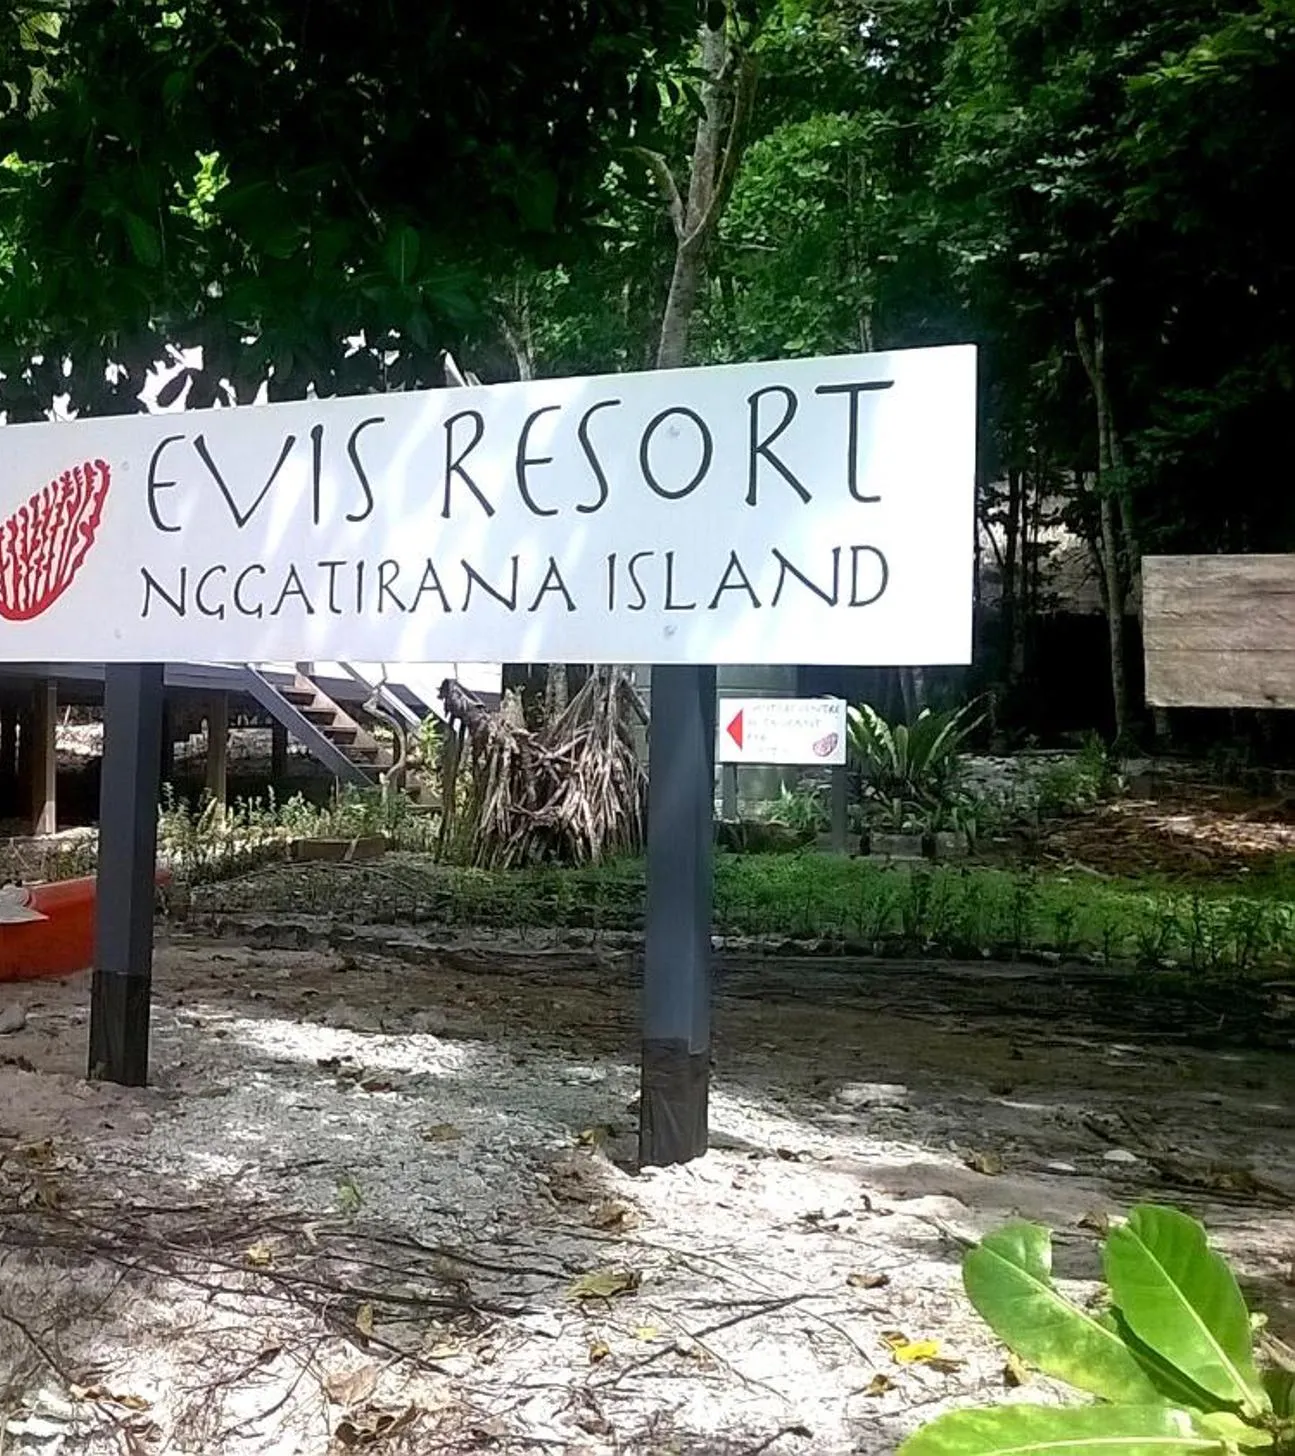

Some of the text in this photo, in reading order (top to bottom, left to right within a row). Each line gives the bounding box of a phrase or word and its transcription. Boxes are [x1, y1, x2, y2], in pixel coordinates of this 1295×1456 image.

[147, 380, 895, 533] EVIS RESORT
[140, 545, 889, 620] NGGATIRANA ISLAND
